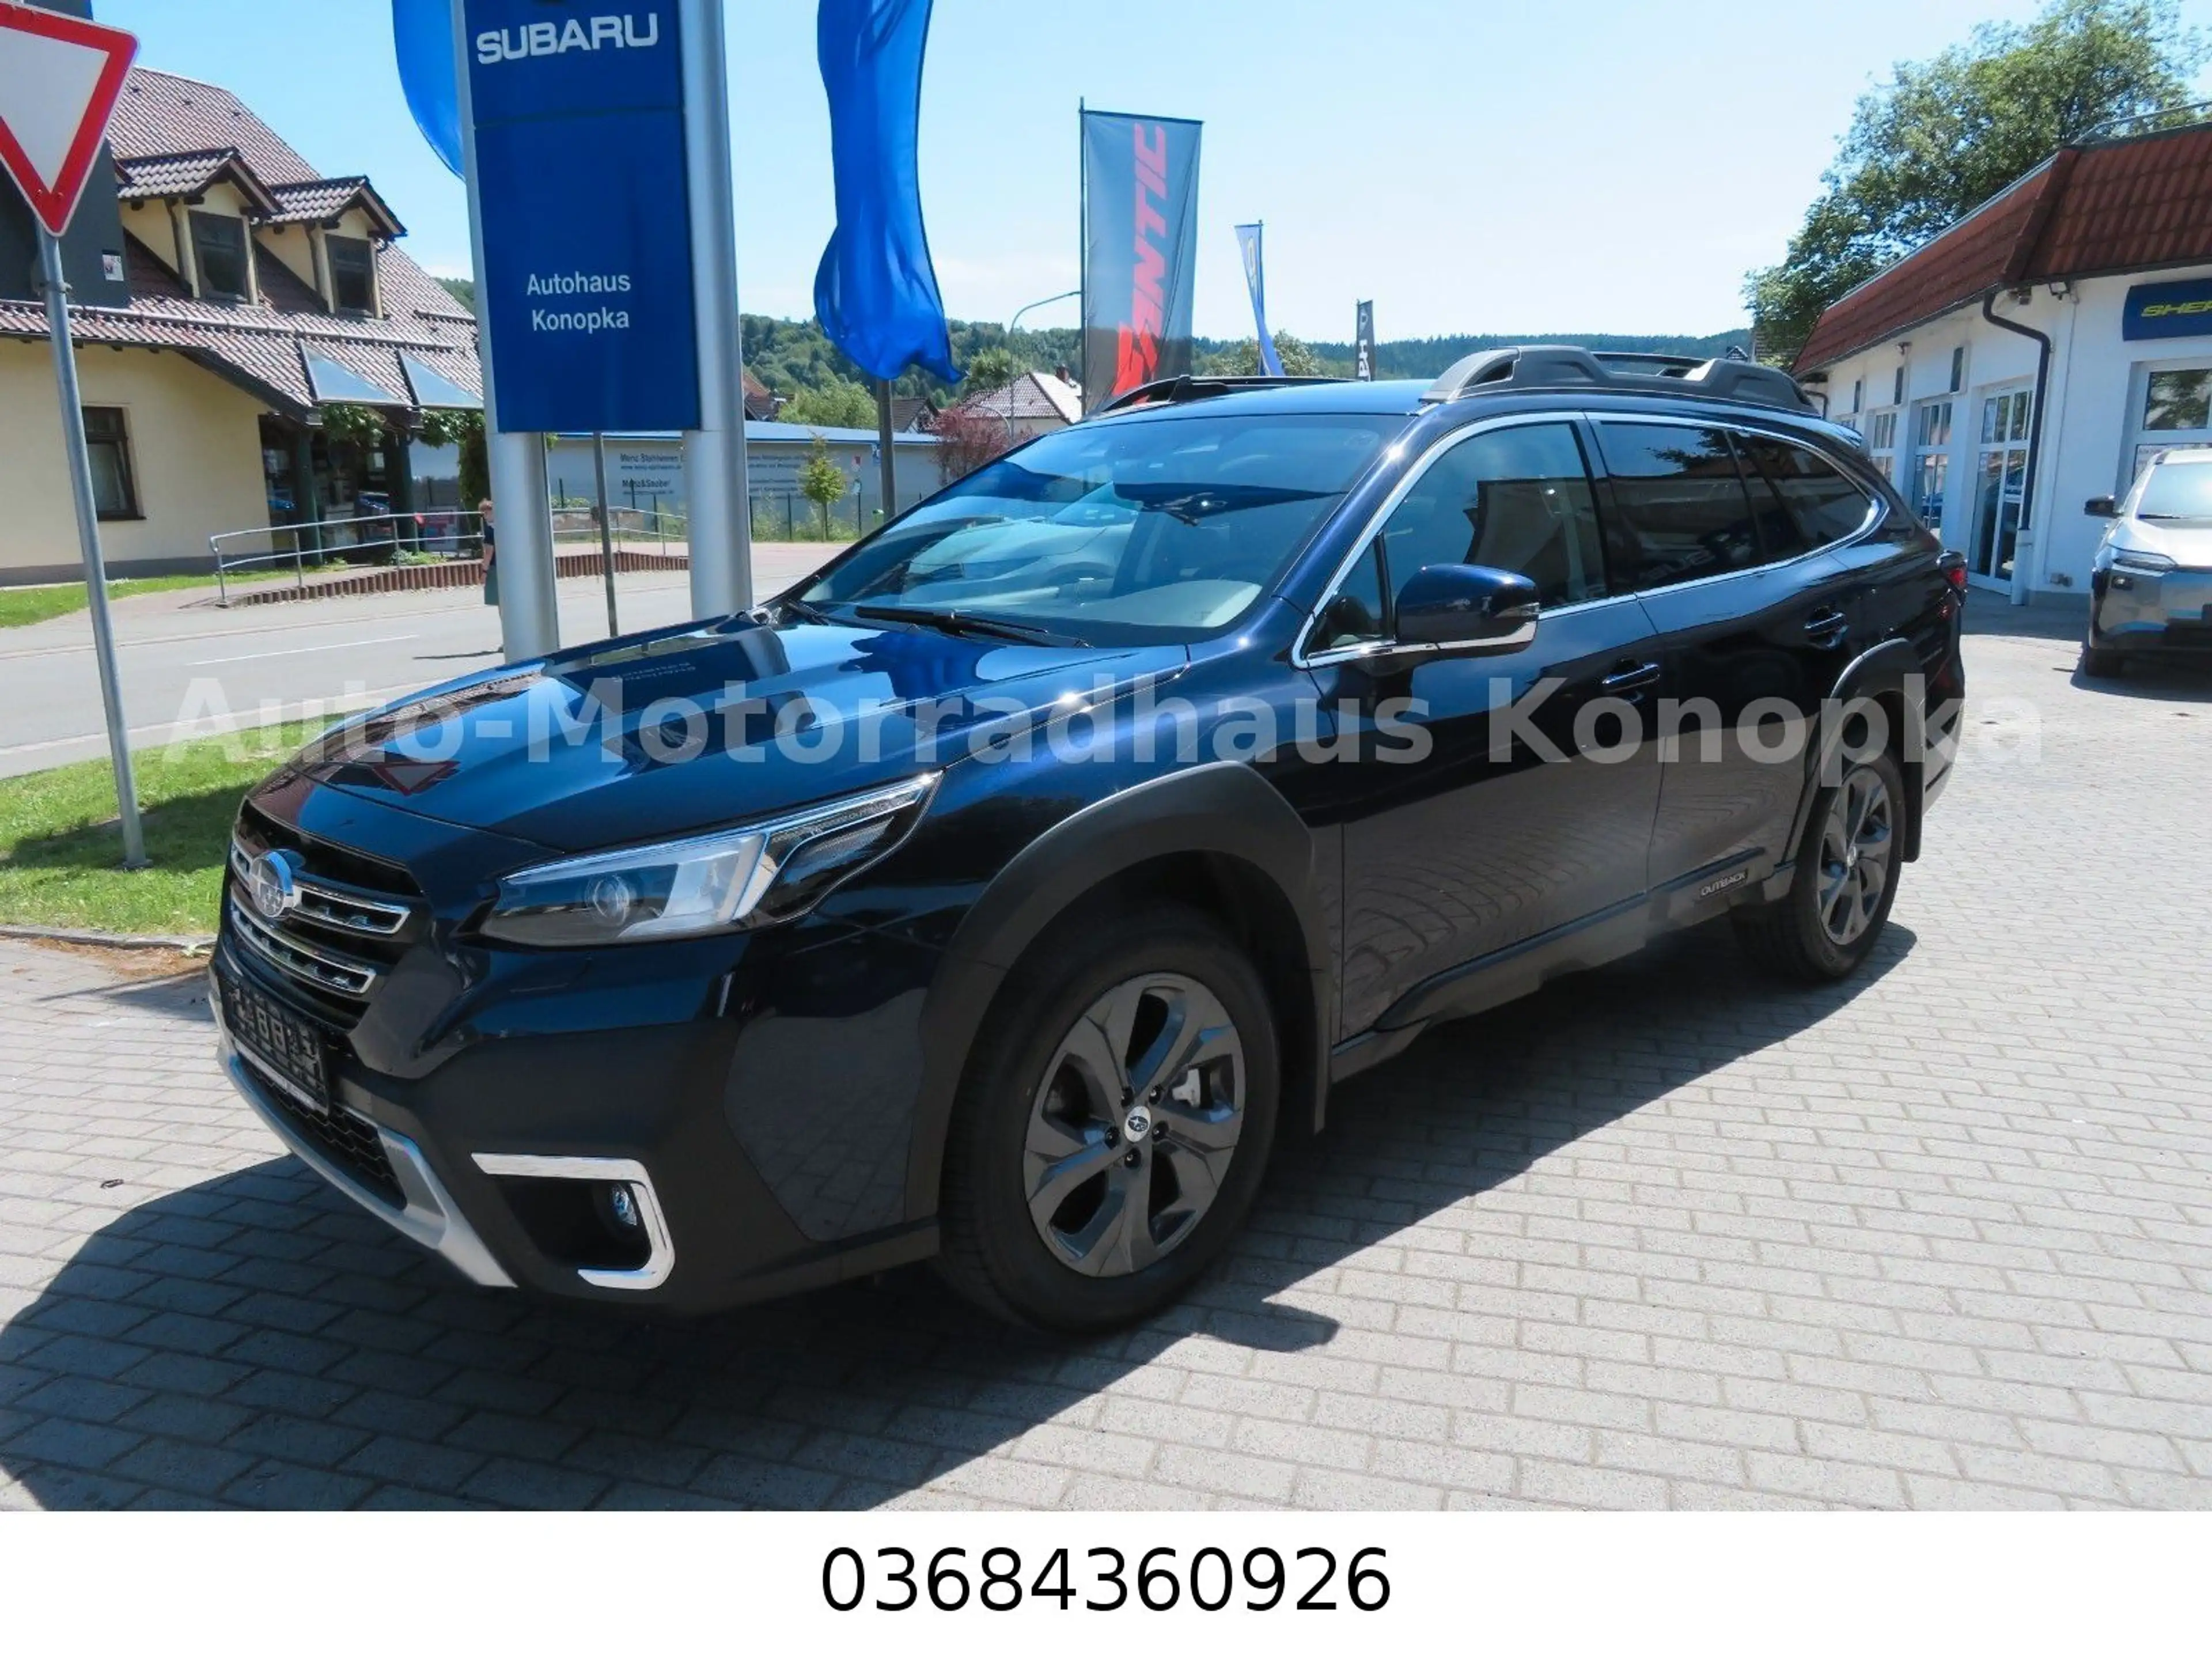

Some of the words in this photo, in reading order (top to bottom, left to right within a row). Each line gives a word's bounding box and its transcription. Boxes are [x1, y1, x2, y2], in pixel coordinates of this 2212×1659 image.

[476, 13, 658, 65] SUBARU
[527, 271, 631, 296] Autohaus
[532, 306, 630, 334] Konopka
[1701, 872, 1747, 896] OUTBACK
